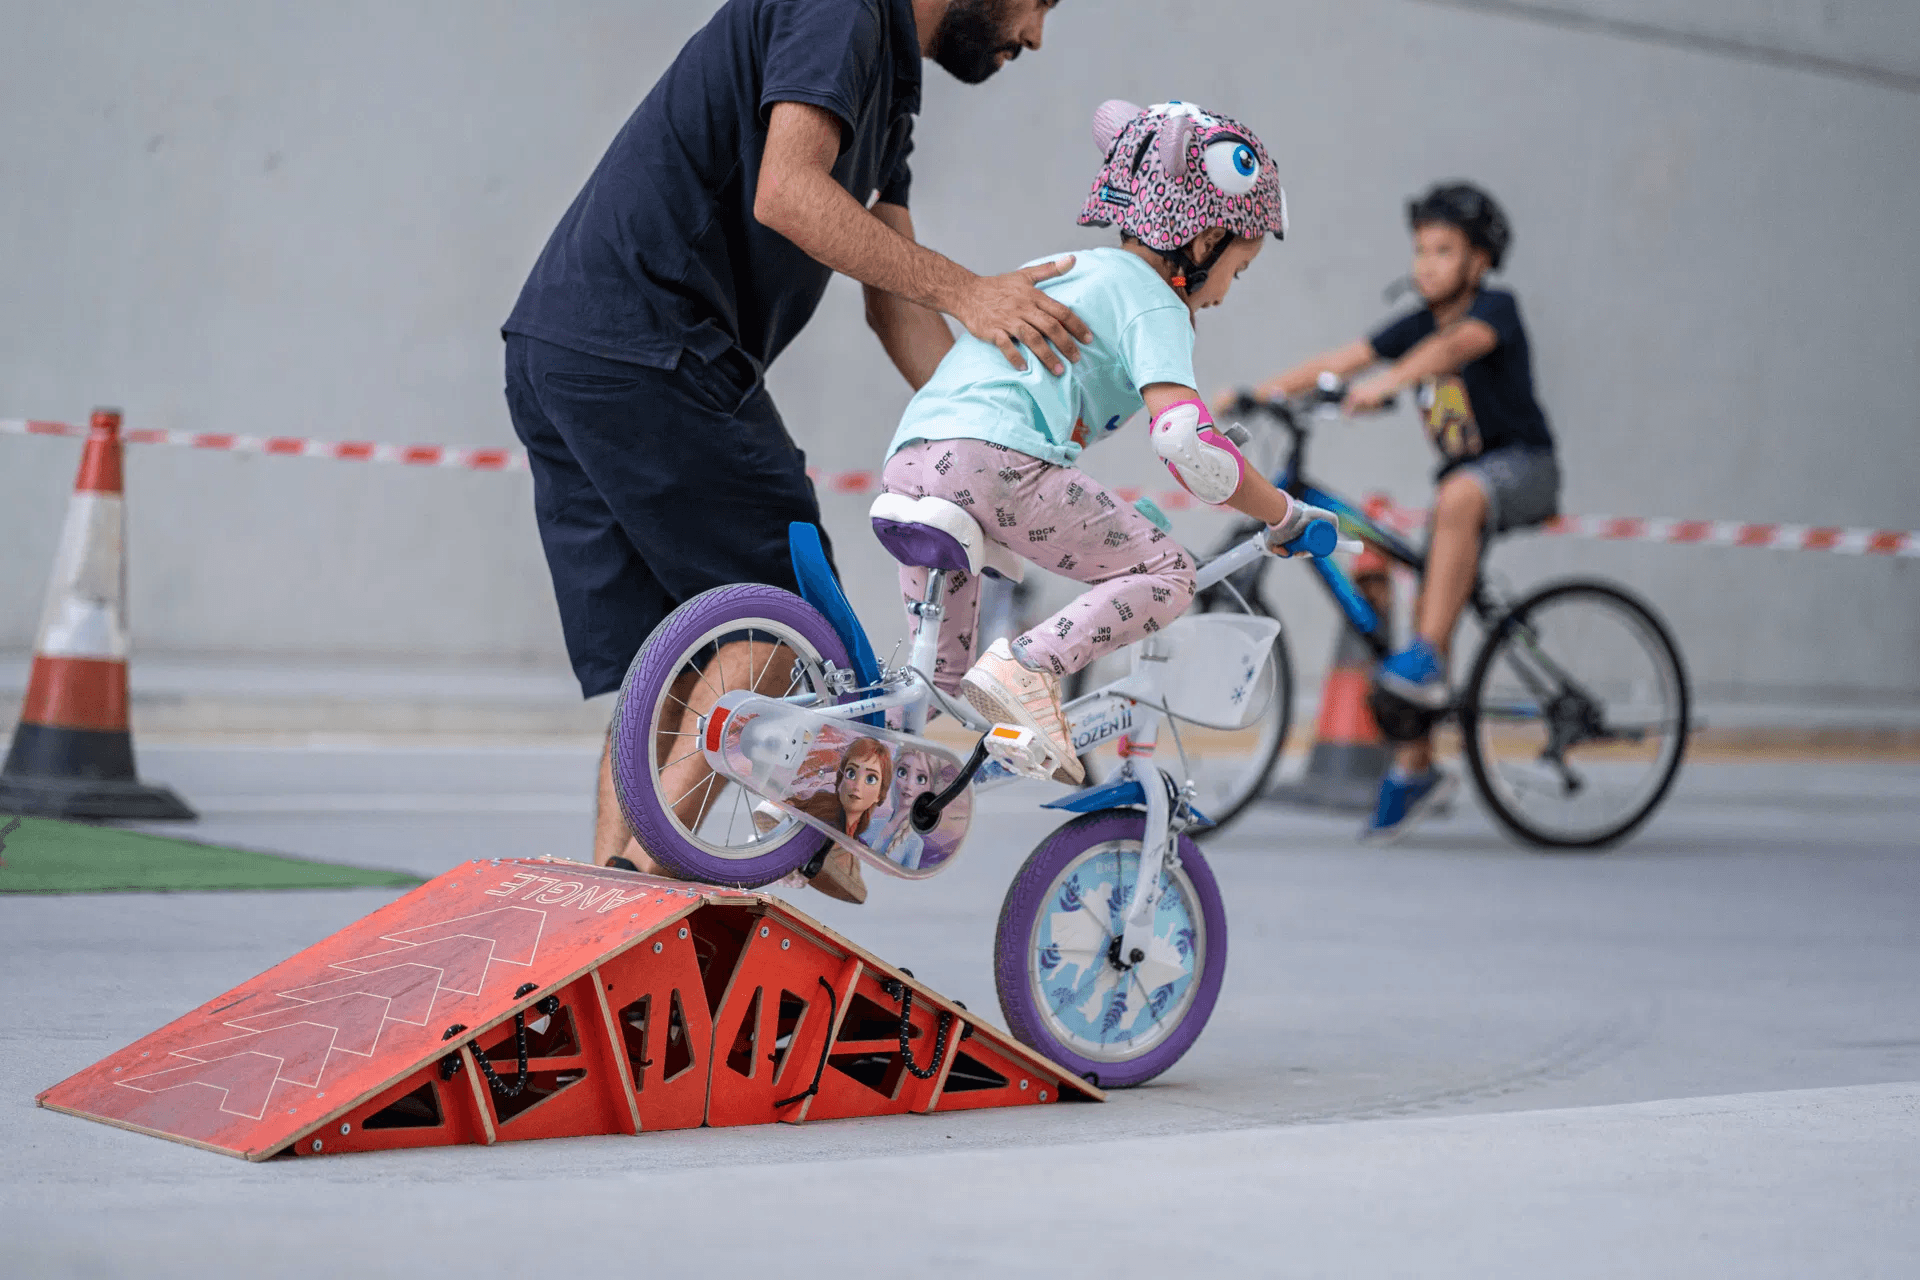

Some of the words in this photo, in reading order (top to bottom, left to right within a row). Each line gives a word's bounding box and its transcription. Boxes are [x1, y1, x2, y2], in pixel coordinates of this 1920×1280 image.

[984, 440, 1009, 453] ROCK
[934, 450, 954, 471] ROCK
[939, 460, 954, 476] ON!
[998, 470, 1015, 484] ON!
[953, 489, 971, 500] ON!
[1066, 482, 1078, 497] ON!
[1067, 485, 1084, 507] ROCK
[954, 496, 976, 507] ROC
[1095, 494, 1108, 509] ON!
[1099, 491, 1117, 510] ROCK
[995, 507, 1008, 528] ROCK
[1005, 512, 1017, 527] ON!
[1028, 525, 1057, 537] ROCK
[1029, 534, 1048, 543] ON!
[1106, 530, 1130, 542] ROCK
[1103, 538, 1120, 548] ON!
[948, 575, 969, 596] ROCK
[1152, 586, 1172, 597] ROCK
[1153, 594, 1166, 604] ON!
[1111, 598, 1128, 622] ROCK
[1121, 602, 1134, 619] ON!
[1055, 617, 1067, 630] ON!
[1057, 619, 1075, 641] ROCK
[1097, 626, 1112, 635] ON!
[1092, 634, 1111, 644] ROCK
[1070, 715, 1119, 750] ROZEN
[484, 871, 648, 914] ANGLE
